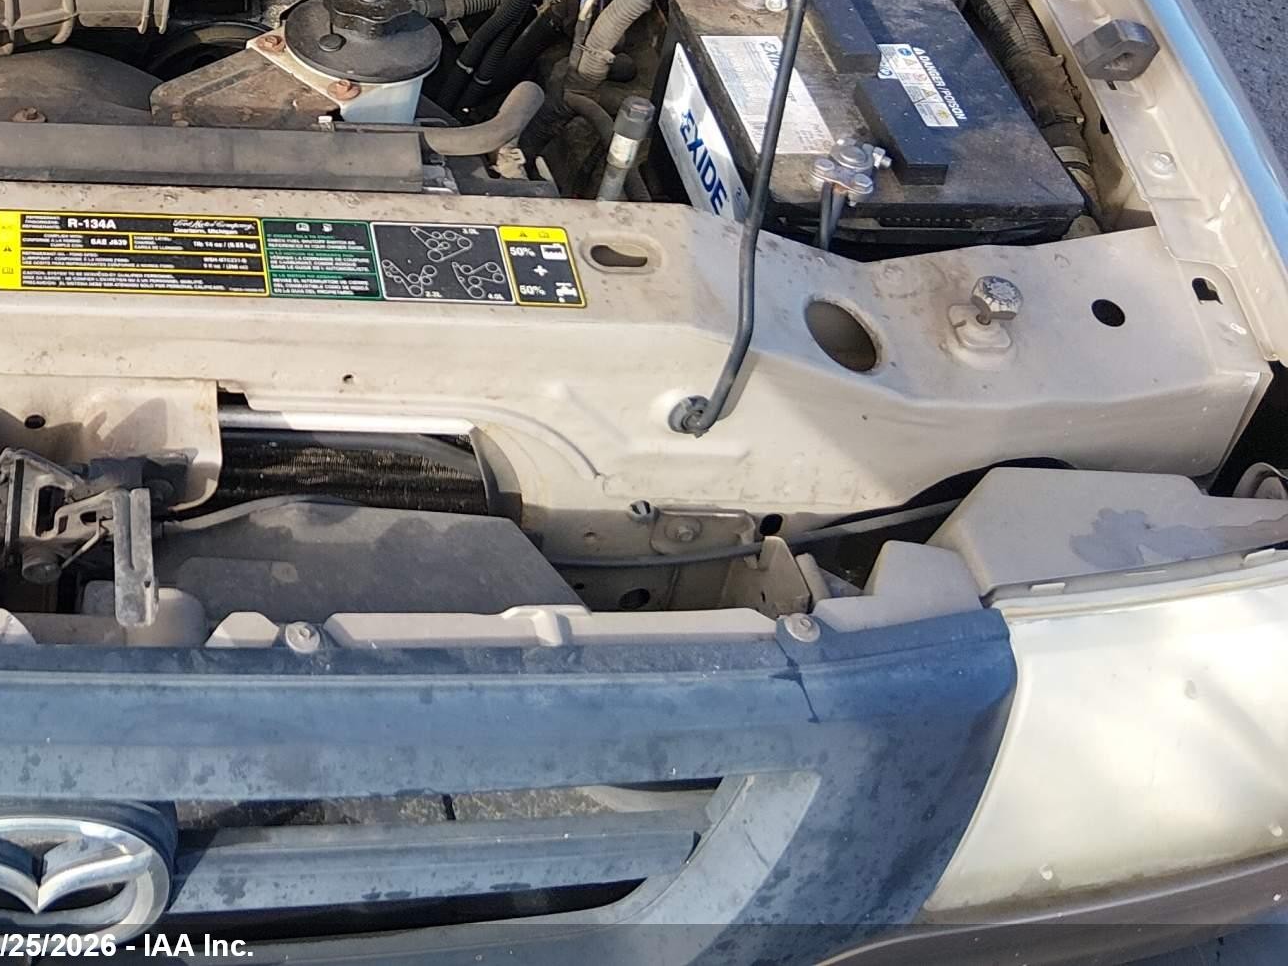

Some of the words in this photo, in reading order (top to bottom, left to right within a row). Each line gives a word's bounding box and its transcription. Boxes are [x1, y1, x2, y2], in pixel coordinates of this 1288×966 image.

[941, 89, 968, 120] POISON
[679, 108, 729, 216] EXIDE
[67, 218, 117, 230] R-134A
[509, 246, 536, 257] 50%
[519, 284, 546, 296] 50%
